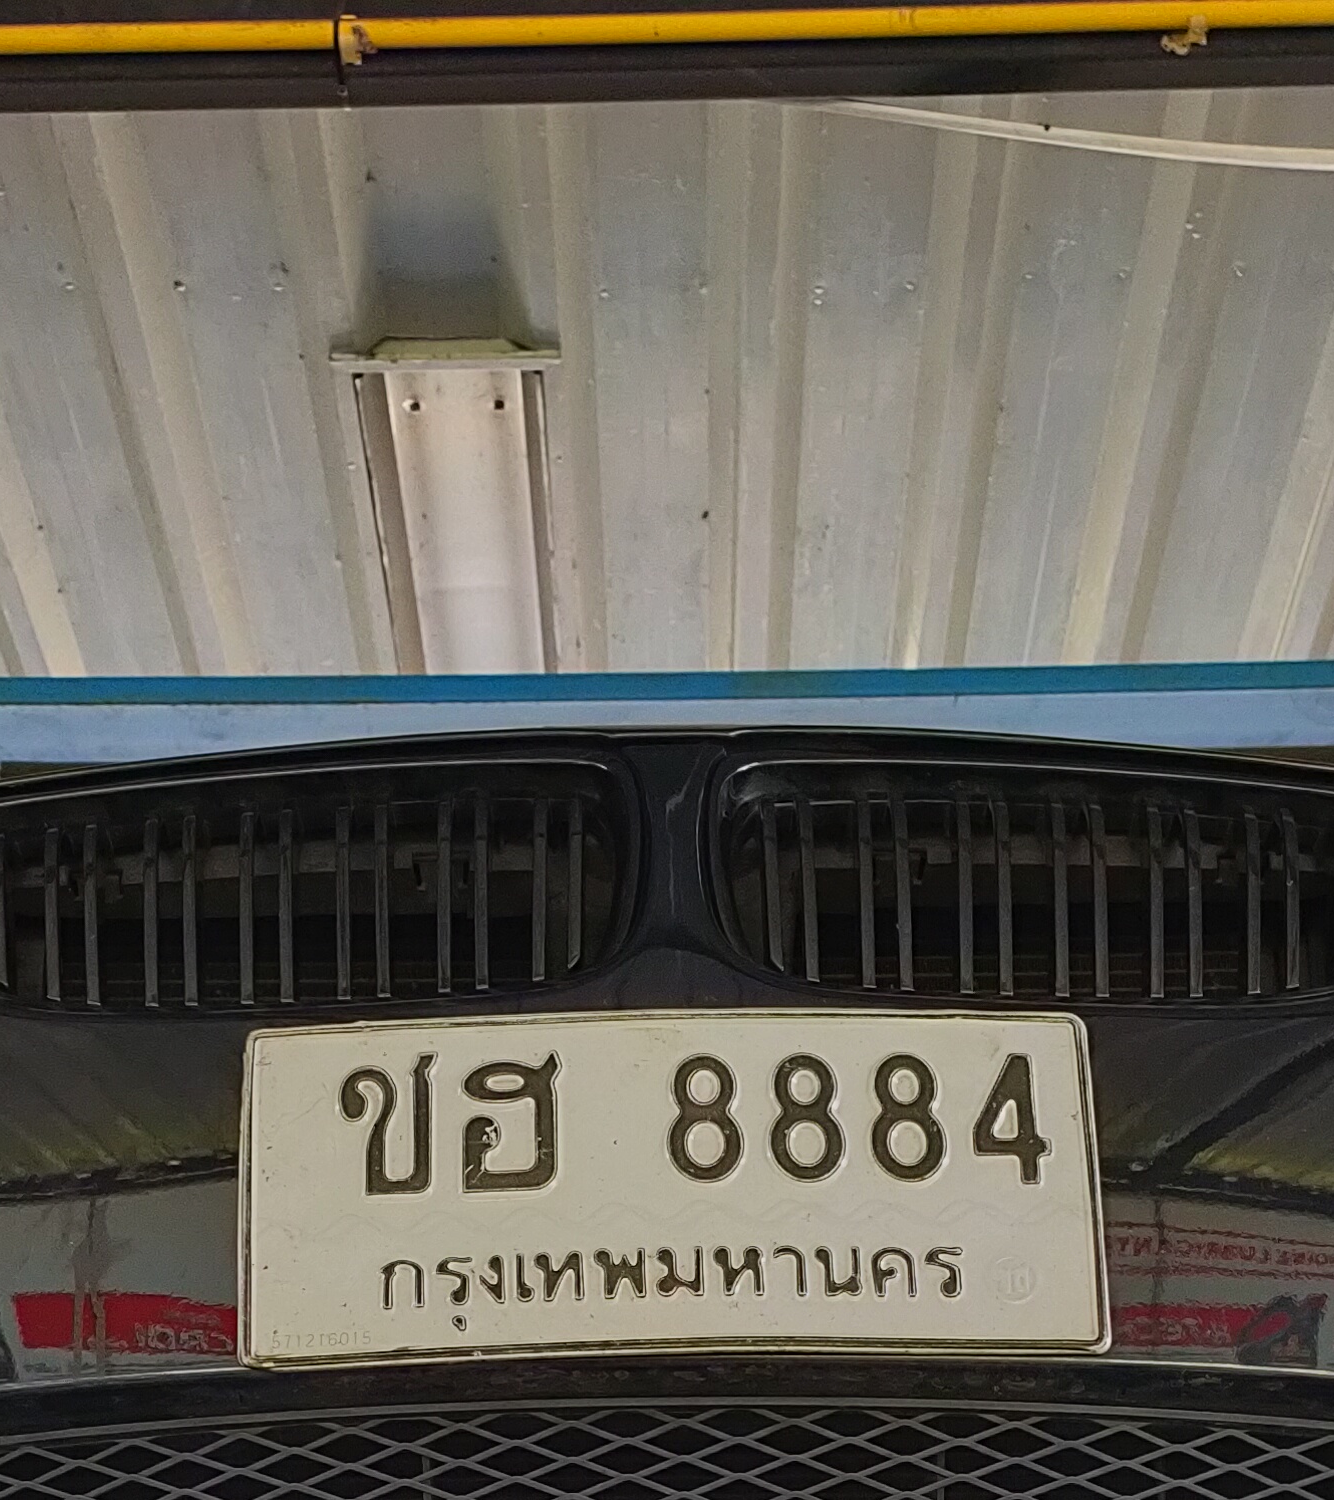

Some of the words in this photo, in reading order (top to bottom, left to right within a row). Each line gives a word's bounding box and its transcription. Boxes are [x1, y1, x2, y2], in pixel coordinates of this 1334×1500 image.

[667, 1051, 1052, 1184] 8884
[380, 1246, 964, 1331] กรุงเทพมหานคร
